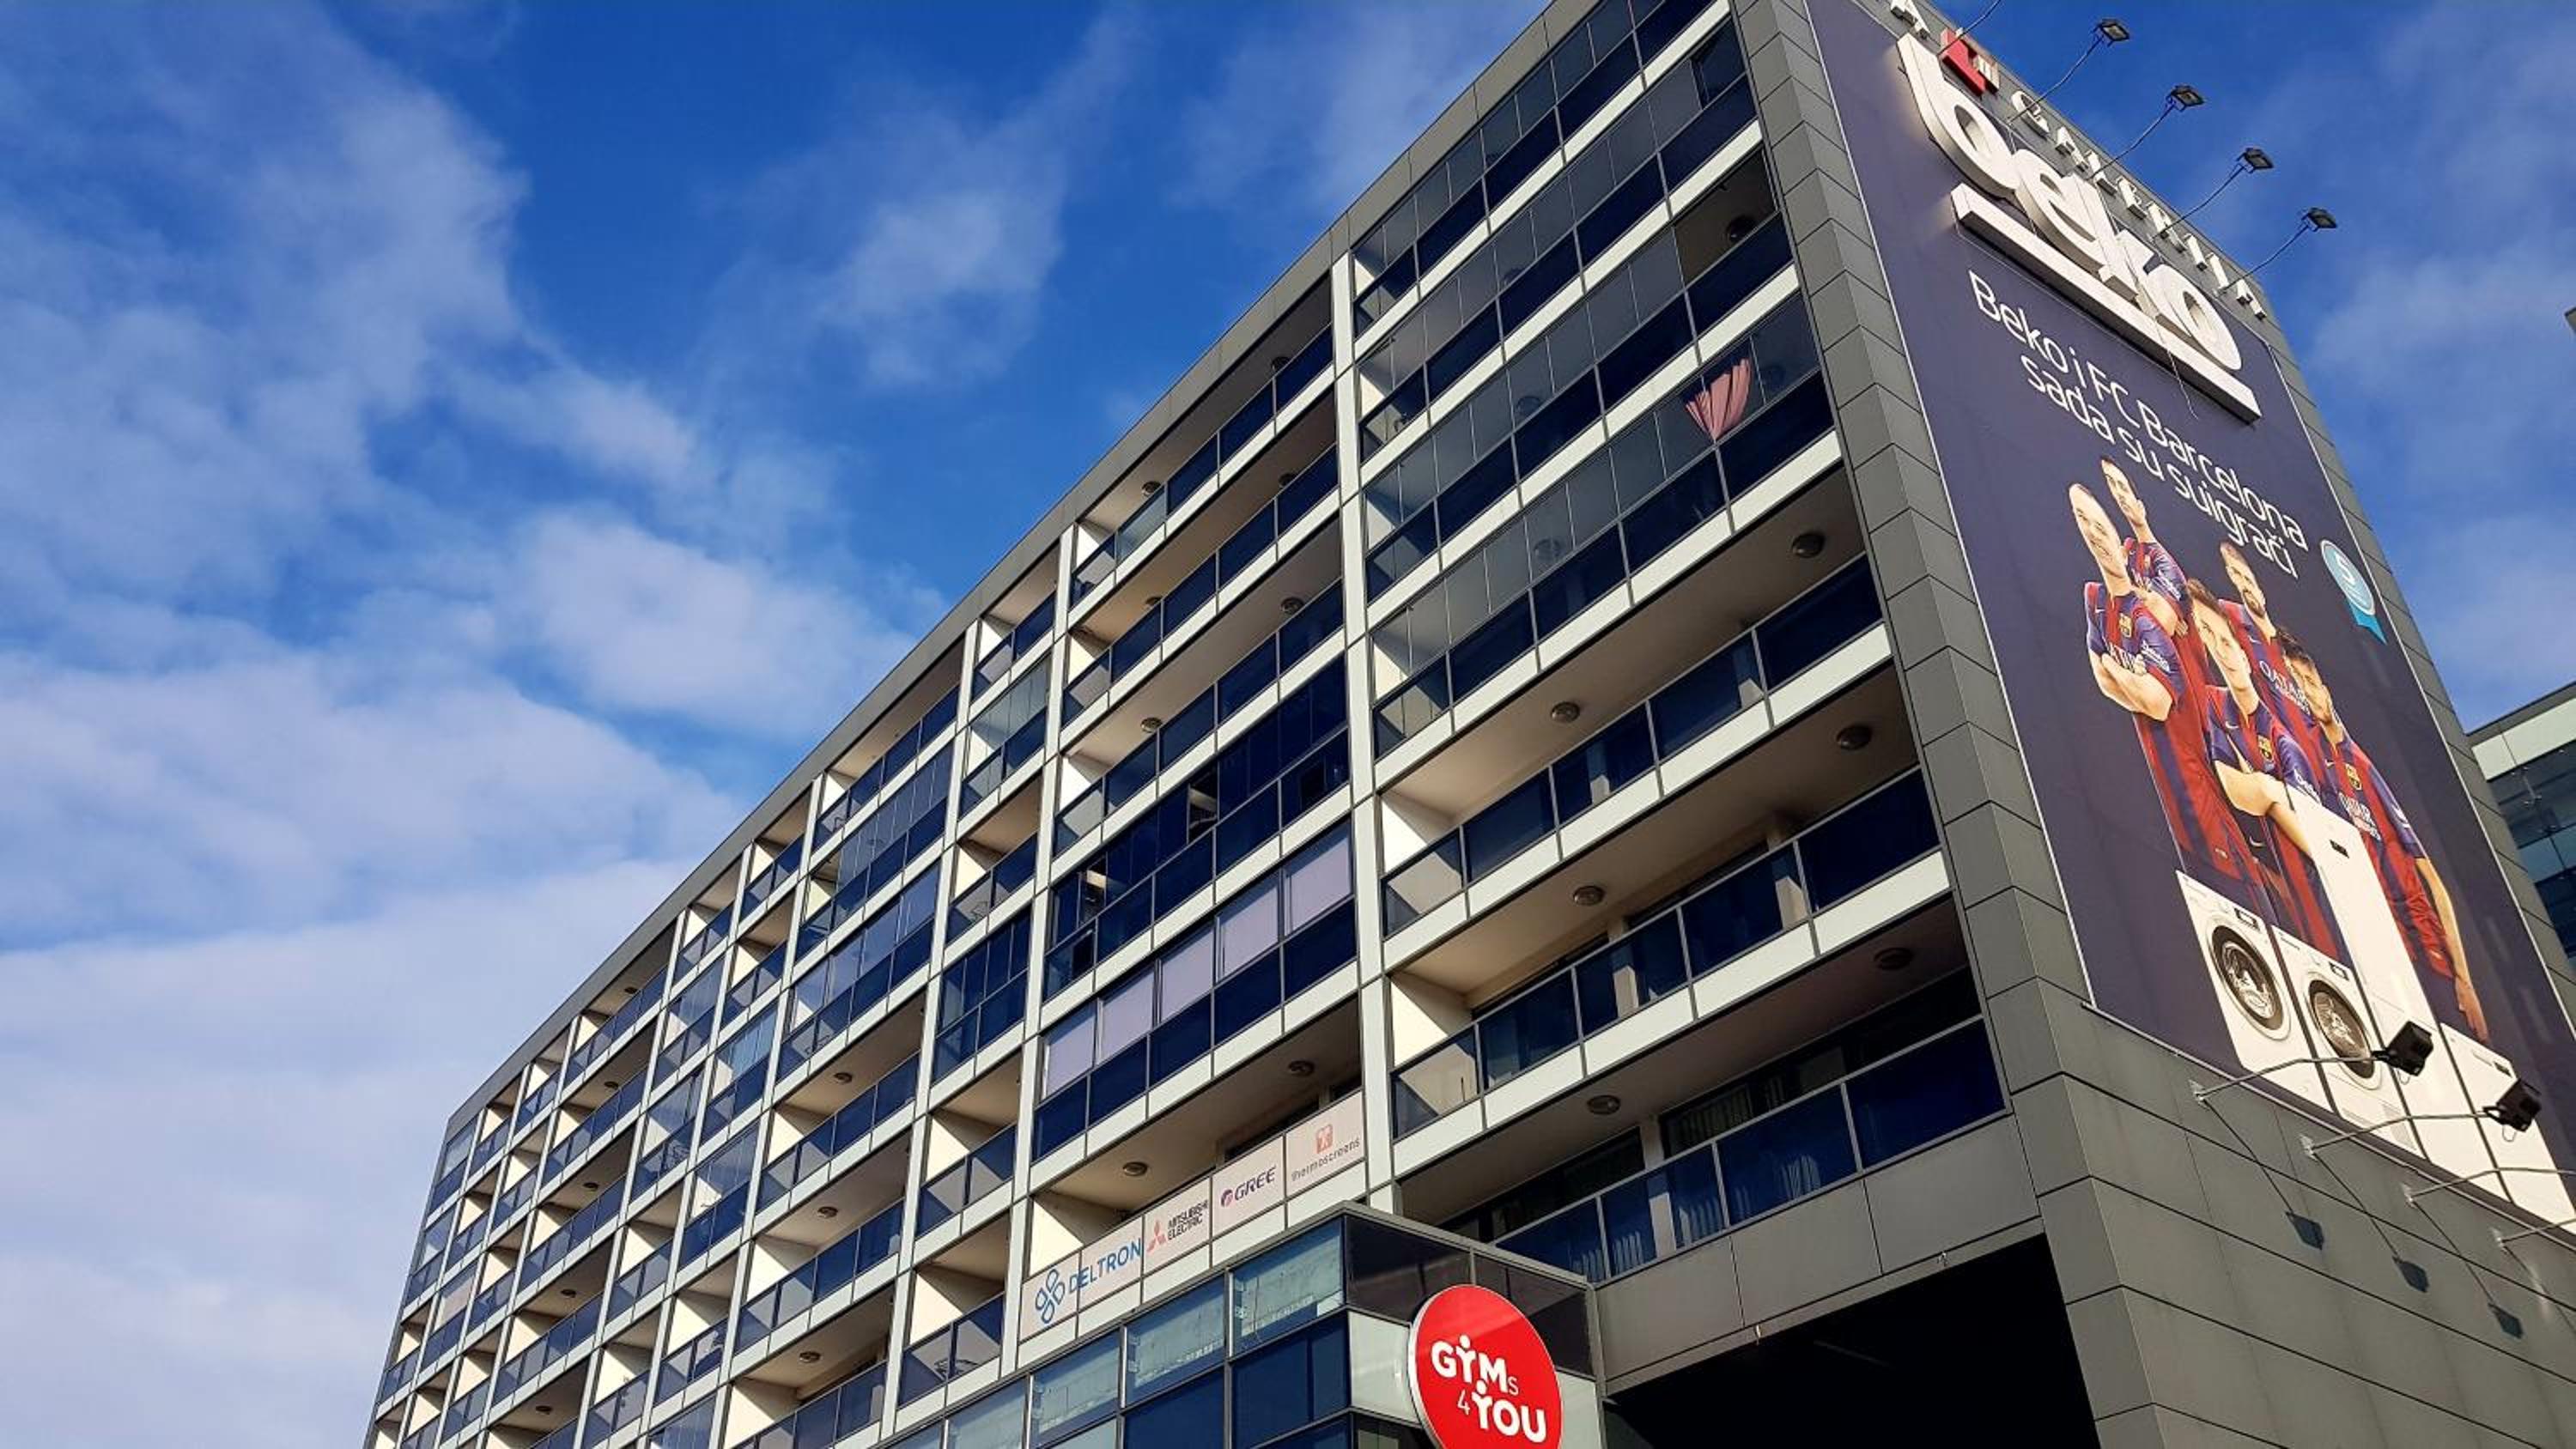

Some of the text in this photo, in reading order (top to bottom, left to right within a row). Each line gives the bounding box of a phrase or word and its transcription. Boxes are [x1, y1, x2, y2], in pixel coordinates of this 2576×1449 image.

[1897, 33, 2244, 372] beko
[1968, 270, 2309, 552] Beko i FC Barcelona
[2020, 354, 2300, 580] sada su suigrači
[1168, 1213, 1203, 1240] ELECTRIC
[1235, 1164, 1276, 1200] GREE
[1069, 1237, 1142, 1294] DELTRON
